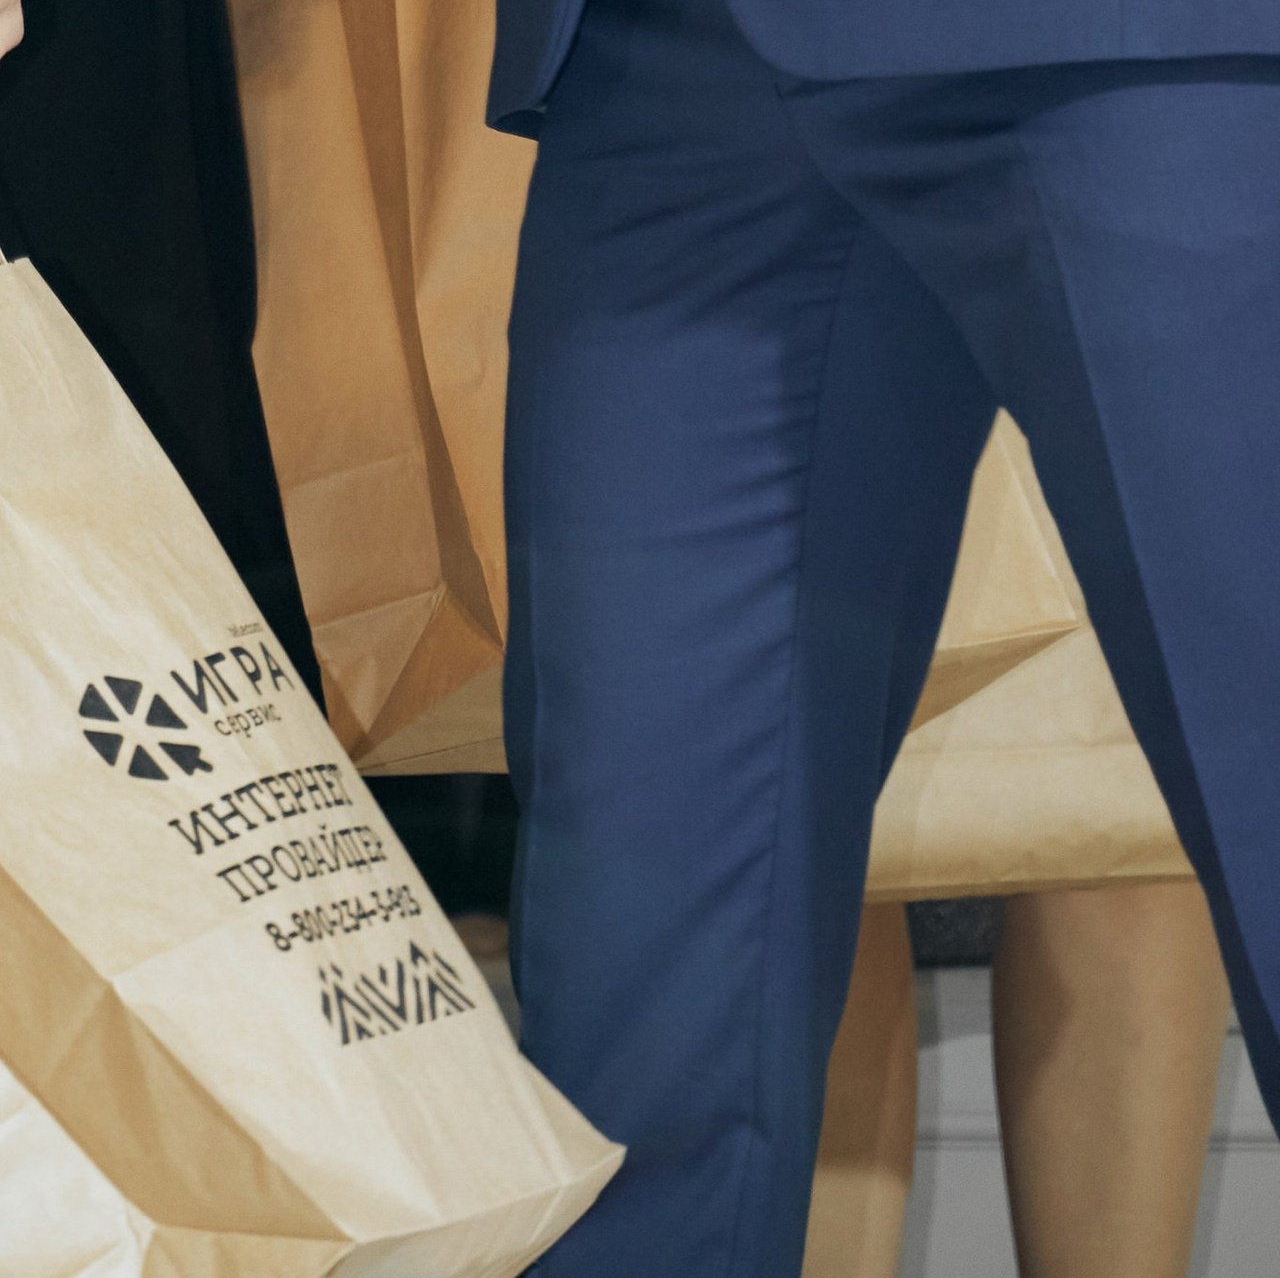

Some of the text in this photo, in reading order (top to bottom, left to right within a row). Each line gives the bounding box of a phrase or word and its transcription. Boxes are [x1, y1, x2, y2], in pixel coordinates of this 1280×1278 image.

[171, 641, 295, 714] ИГРА
[168, 763, 353, 855] ИНТЕРНЕТ
[216, 825, 387, 903] ПРОВАЙДЕР
